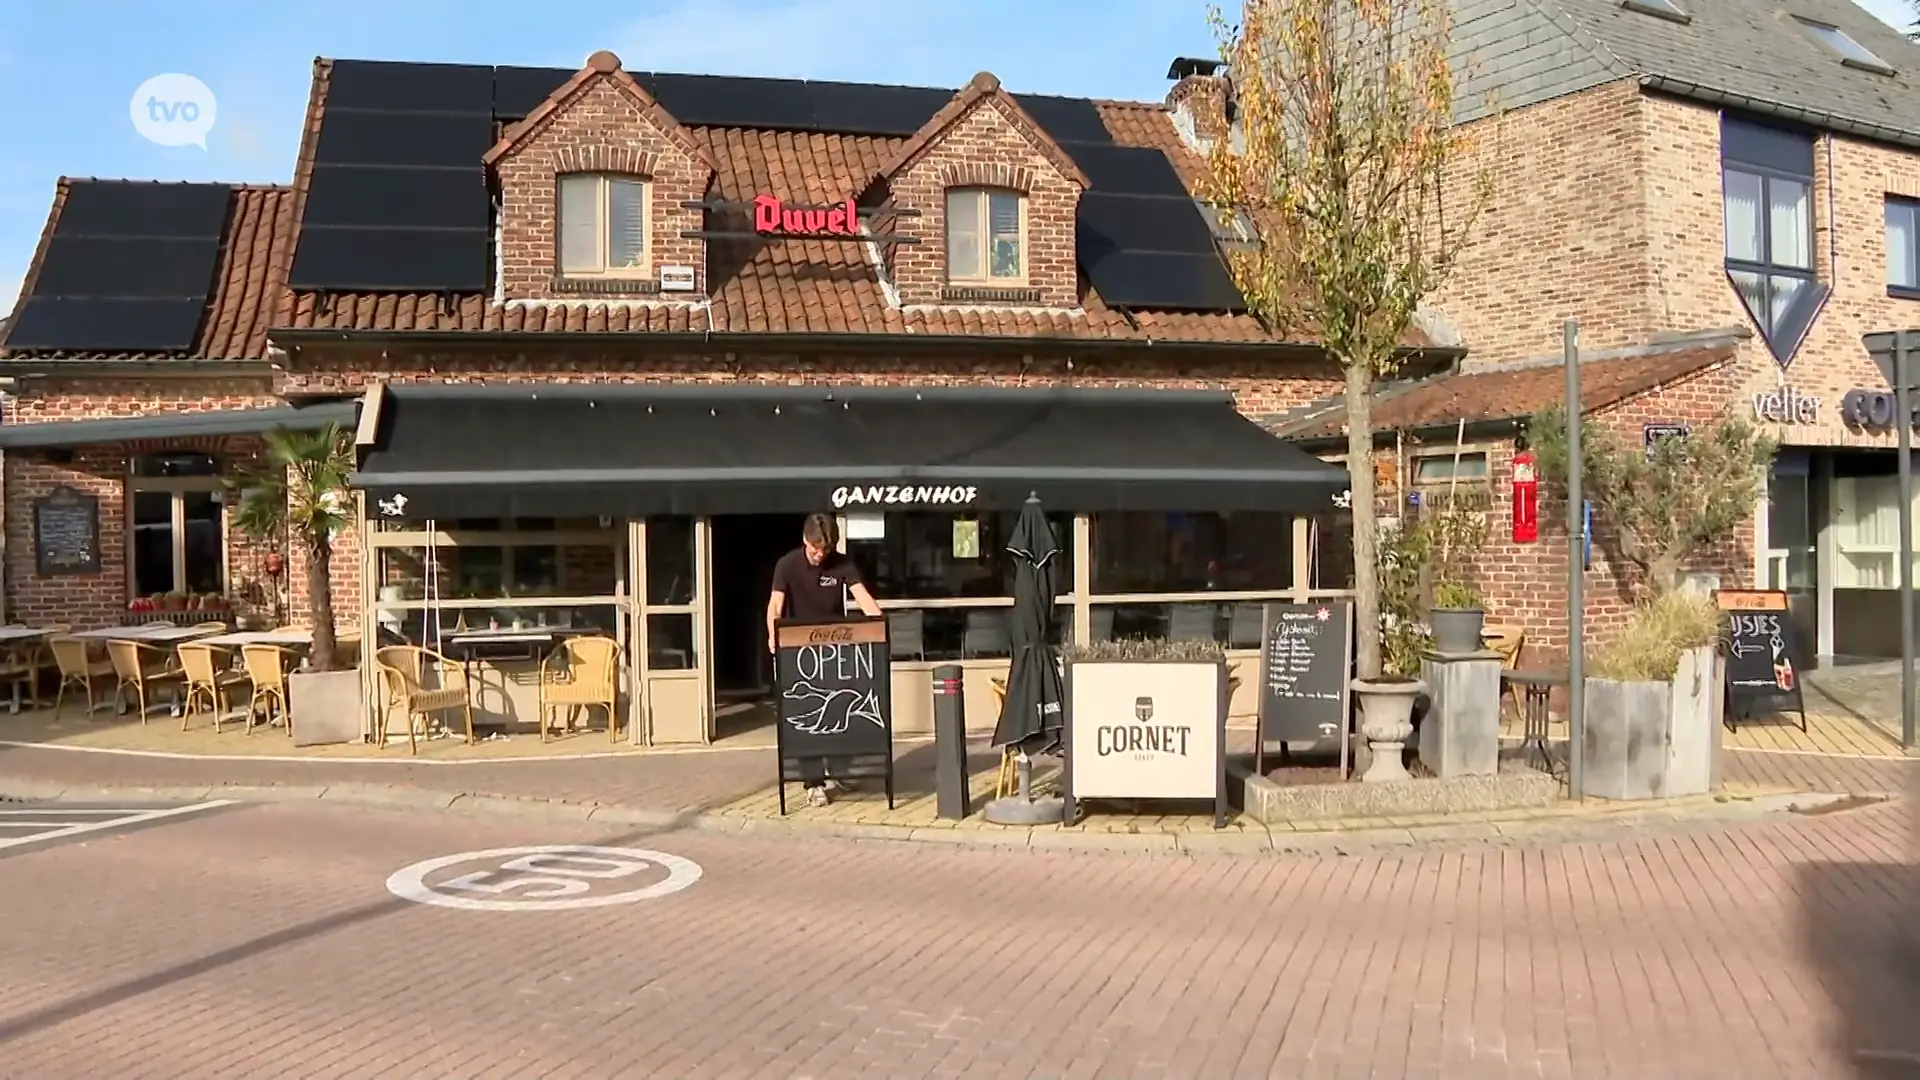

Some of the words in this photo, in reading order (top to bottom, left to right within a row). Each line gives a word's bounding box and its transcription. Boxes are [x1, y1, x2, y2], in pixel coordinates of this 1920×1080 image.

[754, 195, 859, 233] Duvel
[831, 485, 977, 508] GANZENHOF
[796, 644, 874, 681] OPEN
[1097, 725, 1191, 757] CORNET
[435, 854, 650, 897] 50
